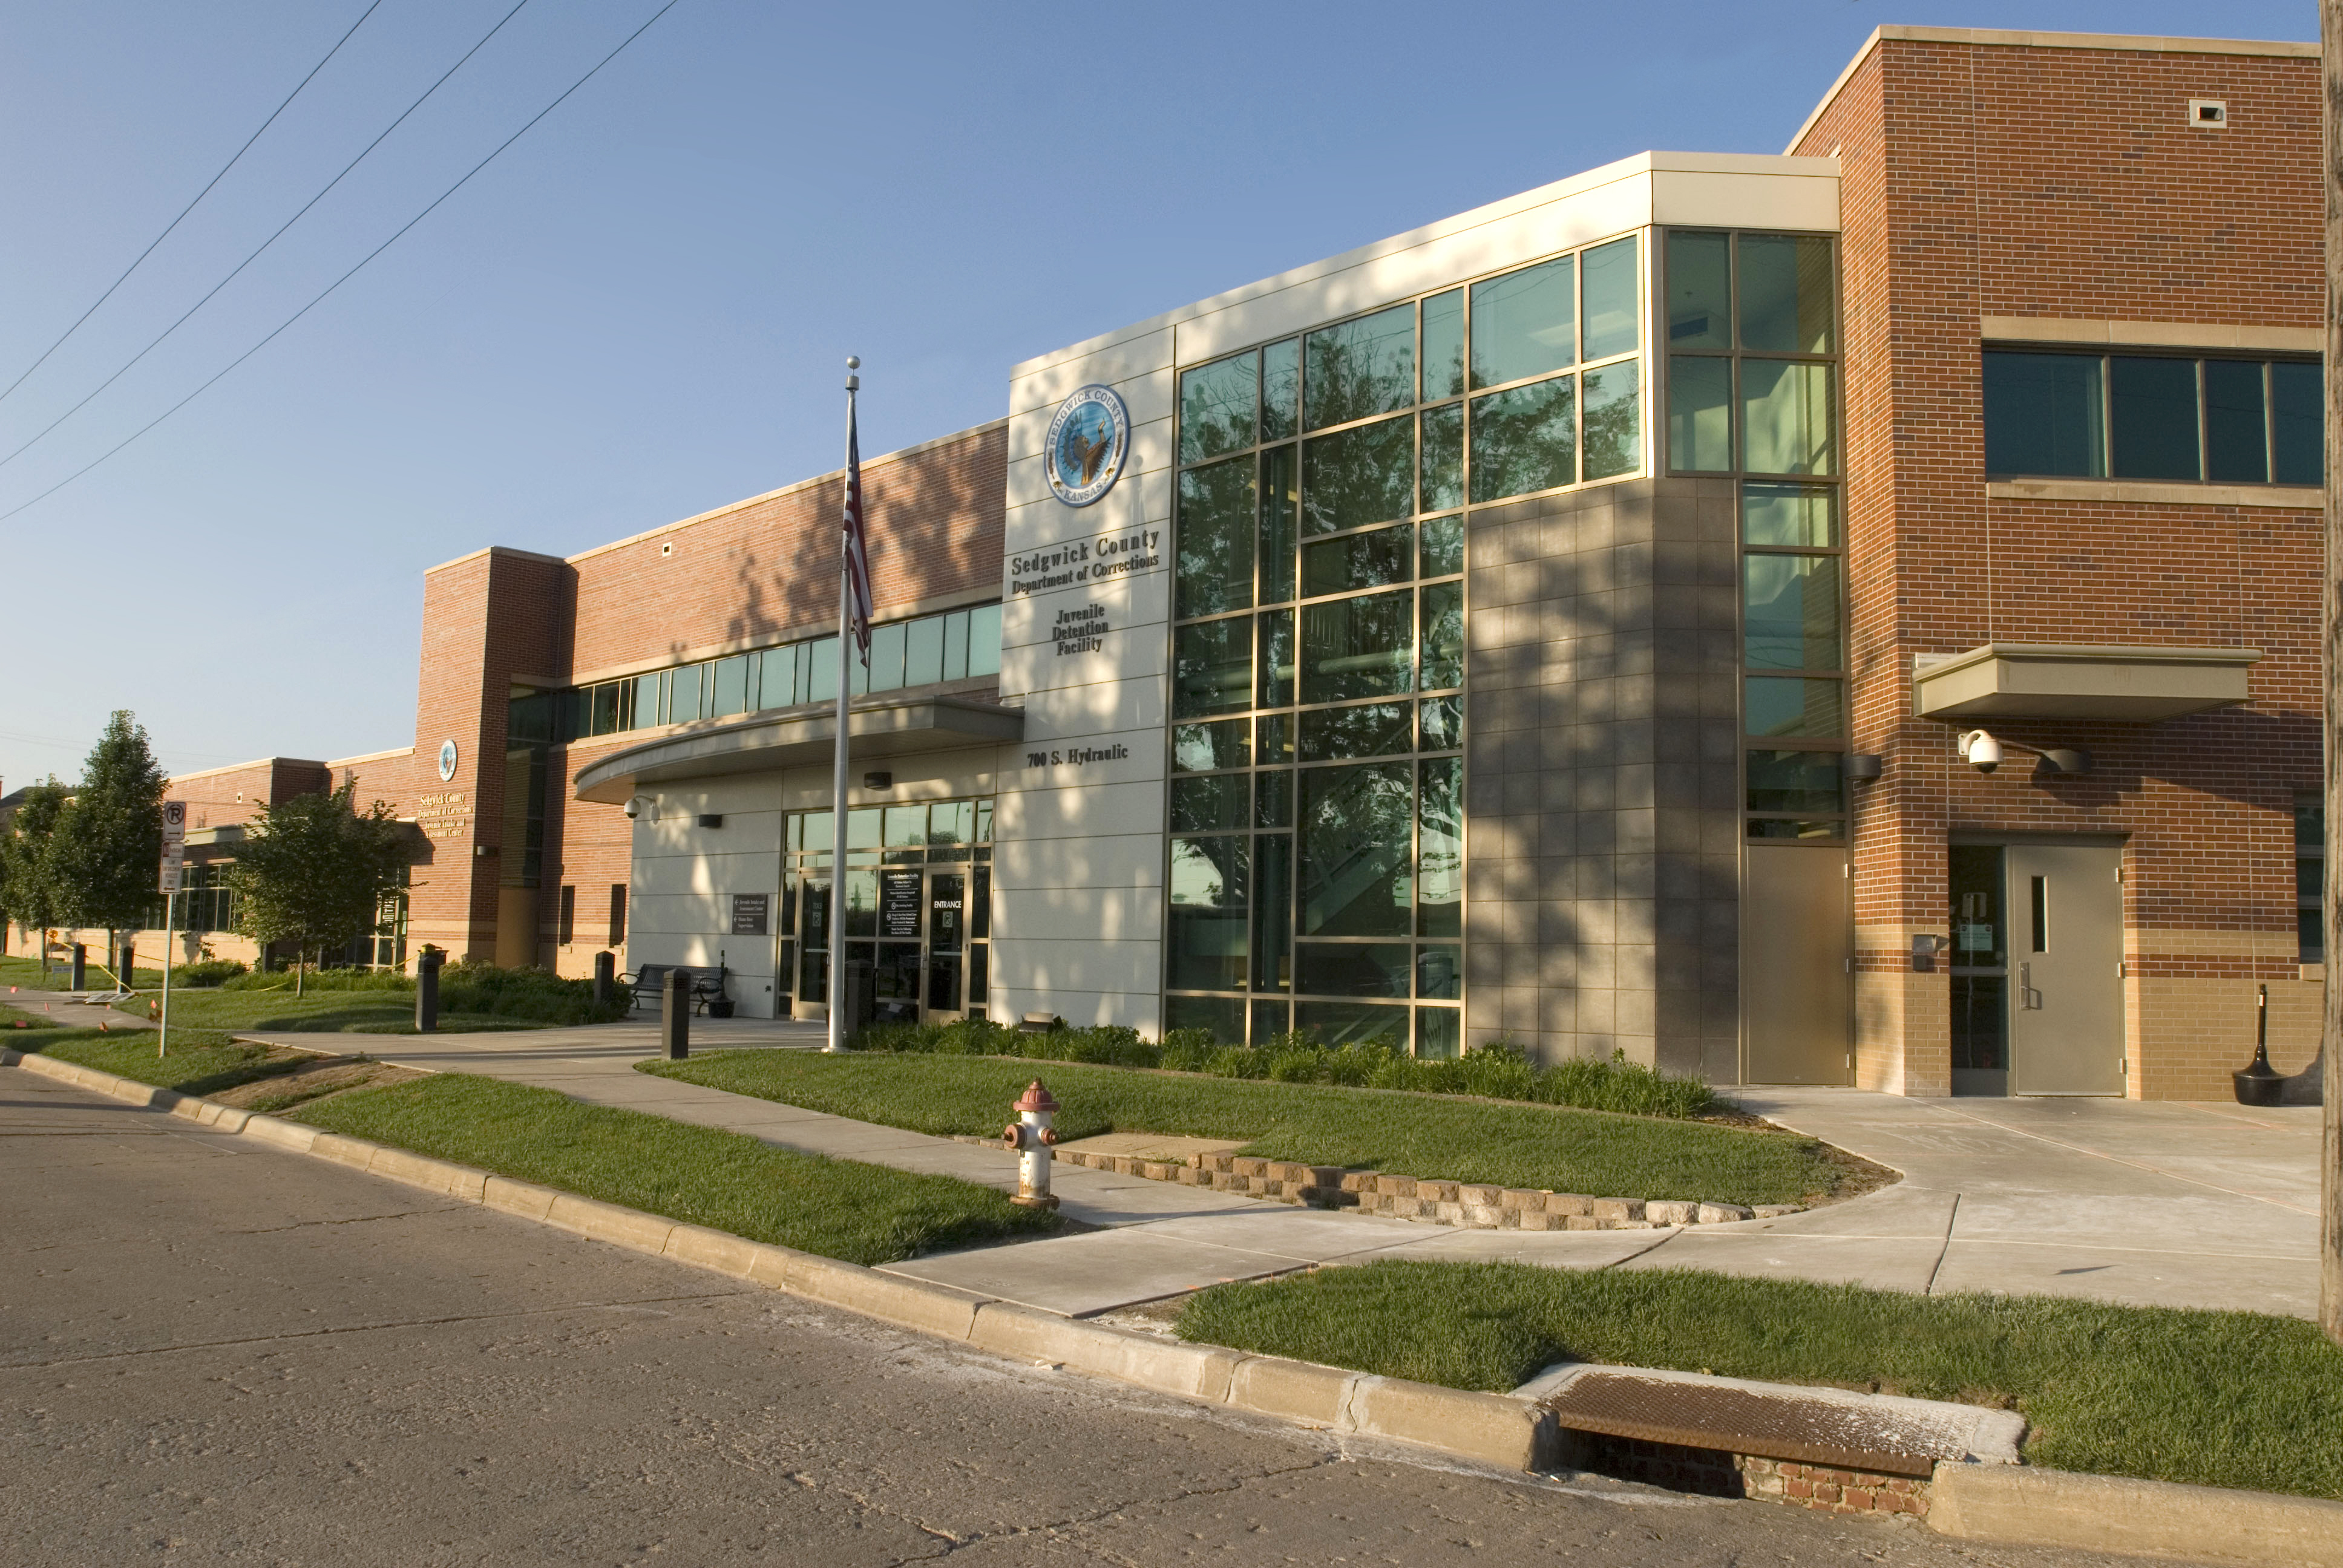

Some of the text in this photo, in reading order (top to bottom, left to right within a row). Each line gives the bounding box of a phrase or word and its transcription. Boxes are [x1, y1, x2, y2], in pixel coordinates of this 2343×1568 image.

[1049, 390, 1124, 445] SEDGWICK COUNTY
[1064, 482, 1102, 501] KANSAS
[1012, 529, 1159, 575] Sedgwick County
[1012, 554, 1159, 595] Department of Corrections
[1056, 604, 1104, 625] Juvenile
[1052, 620, 1108, 641] Detention
[1057, 637, 1103, 656] Facility
[1027, 743, 1128, 767] 700 S. Hydraulic
[421, 793, 465, 807] Sedgwick County
[448, 805, 473, 814] Corrections
